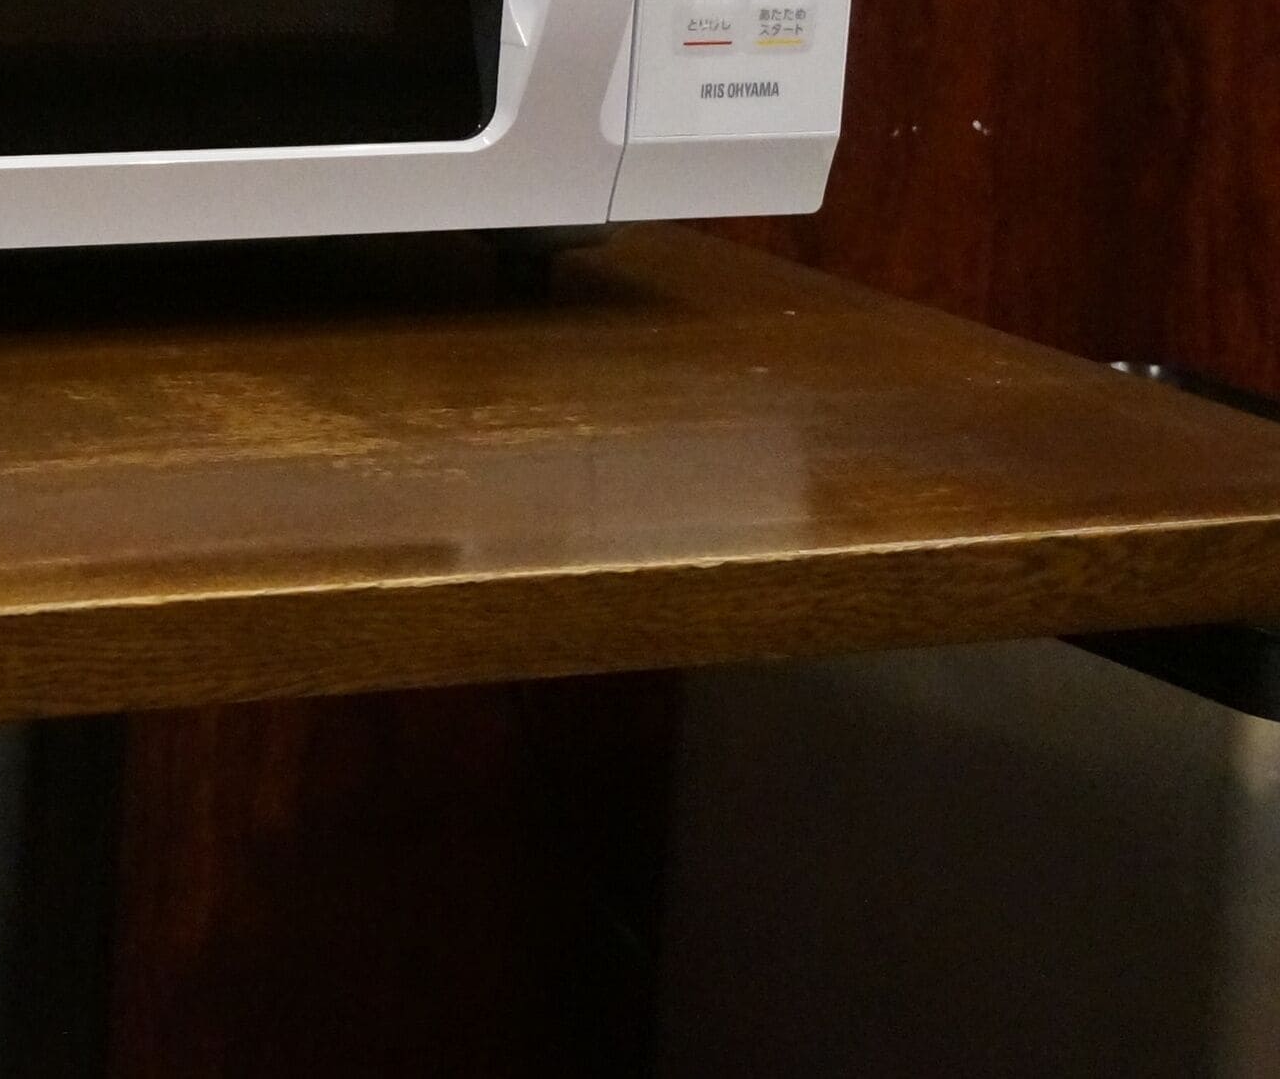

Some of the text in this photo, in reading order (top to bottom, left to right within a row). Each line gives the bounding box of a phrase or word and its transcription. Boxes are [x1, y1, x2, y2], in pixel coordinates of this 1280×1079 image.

[759, 8, 807, 21] あたため
[687, 18, 732, 31] とりけし
[759, 23, 804, 36] スタート
[700, 81, 780, 99] IRIS OHYAMA
